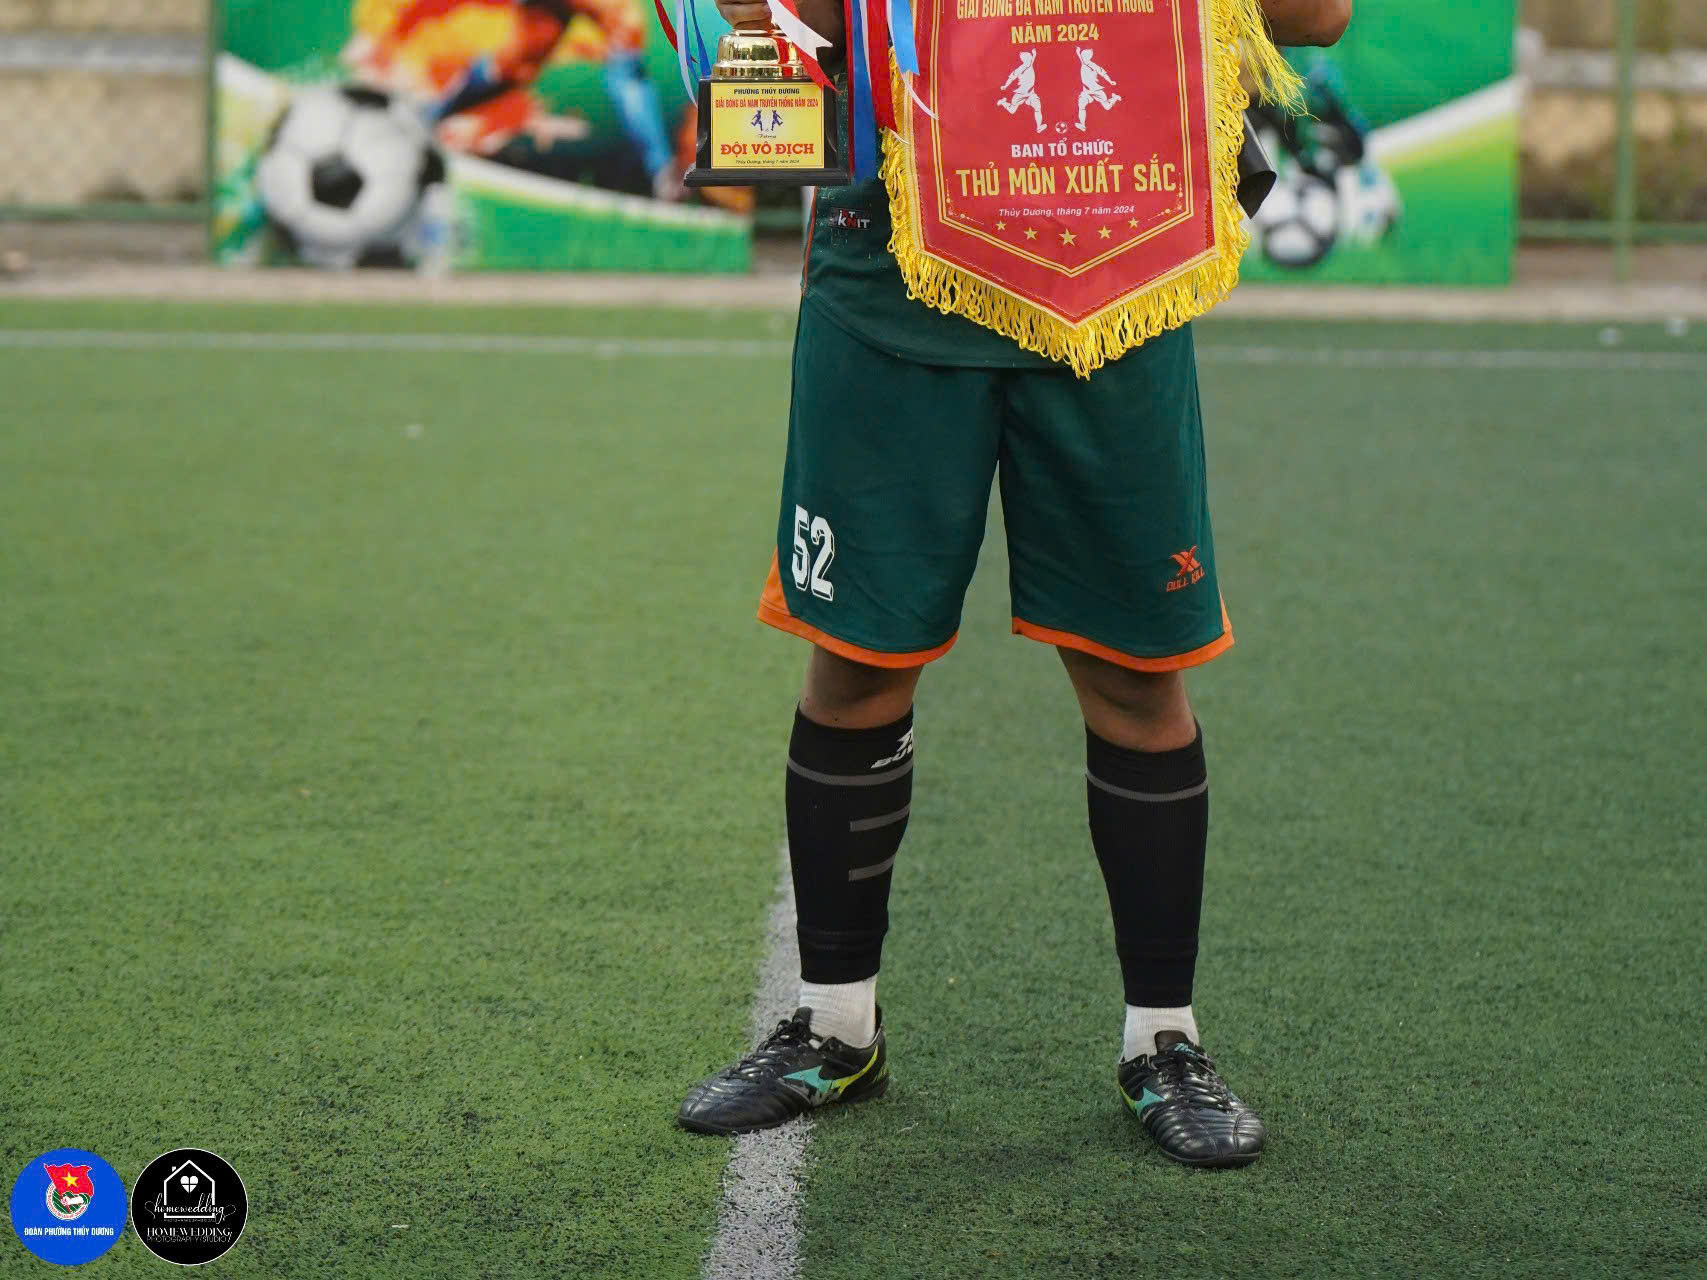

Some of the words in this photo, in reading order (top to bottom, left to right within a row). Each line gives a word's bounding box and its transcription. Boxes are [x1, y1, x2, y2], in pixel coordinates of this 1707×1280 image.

[1011, 21, 1052, 44] NĂM
[1057, 23, 1099, 41] 2024
[720, 141, 747, 158] ĐỘI
[751, 141, 772, 155] VÔ
[775, 143, 815, 158] ĐỊCH
[1011, 143, 1044, 157] BAN
[1047, 137, 1068, 156] TỔ
[1072, 138, 1114, 155] CHỨC
[955, 161, 1000, 196] THỦ
[1008, 162, 1056, 195] MÔN
[1064, 157, 1124, 194] XUẤT
[1133, 153, 1177, 192] SẮC
[999, 208, 1021, 217] Thủy
[1057, 206, 1082, 216] tháng
[1084, 206, 1091, 214] 7
[1092, 206, 1111, 215] năm
[1113, 204, 1136, 214] 2024
[791, 504, 834, 602] 52
